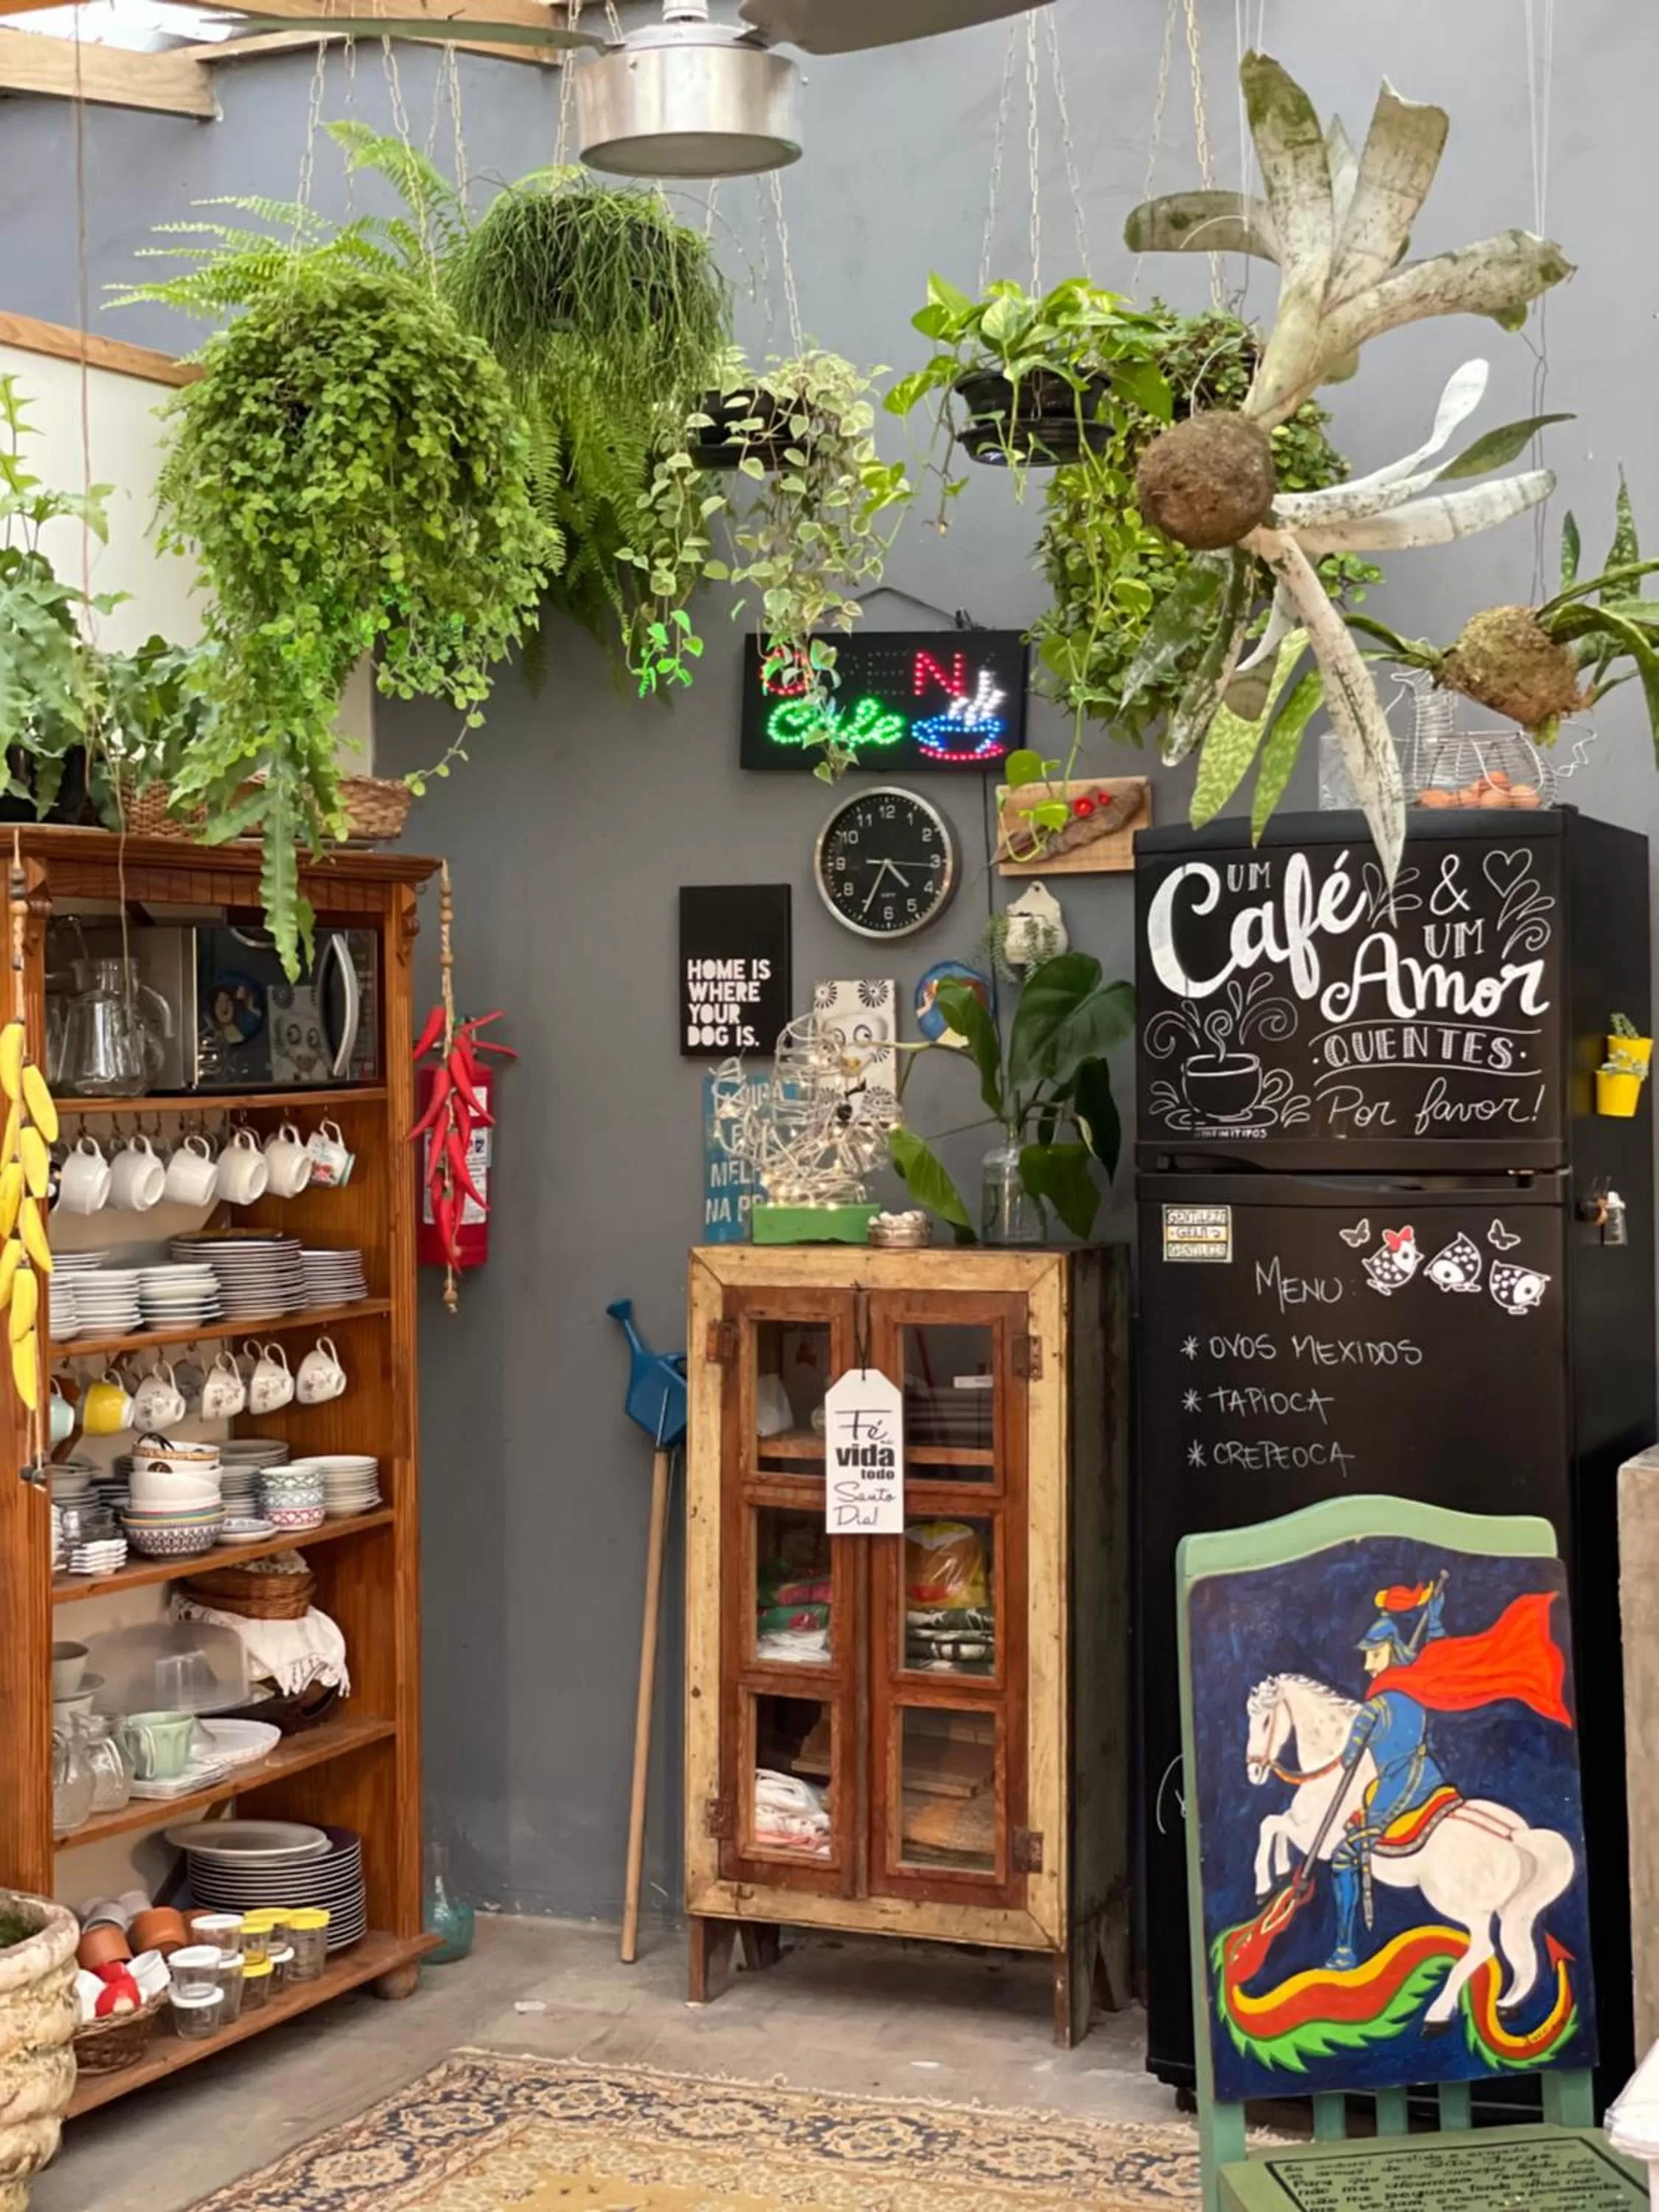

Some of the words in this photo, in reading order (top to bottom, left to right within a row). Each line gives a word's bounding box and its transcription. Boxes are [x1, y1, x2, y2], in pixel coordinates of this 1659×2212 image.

[857, 814, 873, 827] 11
[879, 805, 896, 819] 12
[907, 813, 914, 825] 1
[841, 830, 859, 844] 10
[922, 828, 932, 842] 2
[835, 857, 846, 871] 9
[930, 854, 940, 868] 3
[923, 880, 933, 893] 4
[1227, 862, 1271, 893] UM
[1430, 855, 1471, 915] &
[844, 883, 854, 896] 8
[884, 906, 894, 920] 6
[907, 898, 917, 912] 5
[1147, 849, 1367, 1000] Café
[1422, 919, 1485, 958] UM
[687, 959, 745, 980] HOME
[751, 959, 772, 980] IS
[1320, 932, 1550, 1023] Amor
[688, 981, 761, 1002] WHERE
[688, 1003, 740, 1024] YOUR
[687, 1026, 729, 1046] DOG
[736, 1026, 759, 1046] IS.
[1324, 1027, 1513, 1068] QUENTES
[1316, 1085, 1397, 1126] Por
[1415, 1077, 1546, 1135] favor!
[706, 1197, 731, 1225] NA
[1209, 1334, 1277, 1360] OVOS
[1291, 1335, 1422, 1366] MEXIDOS
[835, 1409, 893, 1441] Fé
[835, 1443, 895, 1467] vida
[1214, 1440, 1356, 1478] CREPEOCA
[860, 1469, 895, 1480] todo
[833, 1481, 897, 1503] Santo
